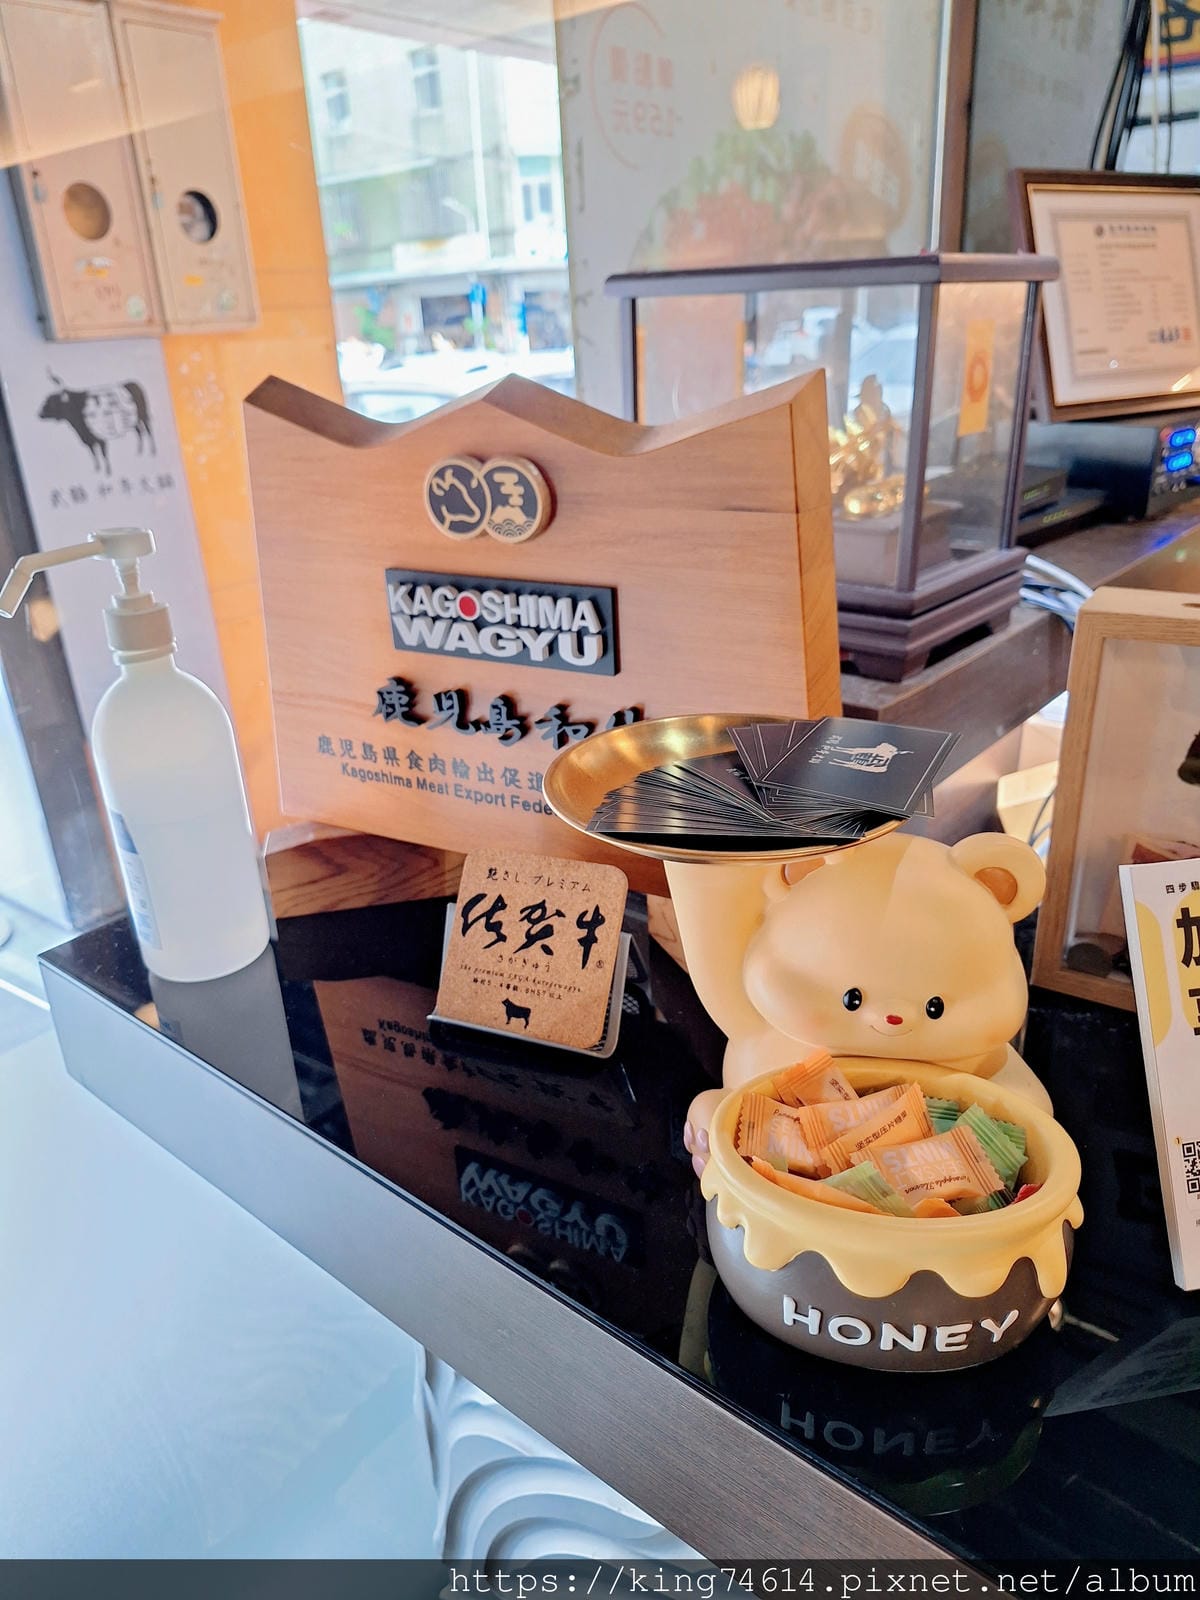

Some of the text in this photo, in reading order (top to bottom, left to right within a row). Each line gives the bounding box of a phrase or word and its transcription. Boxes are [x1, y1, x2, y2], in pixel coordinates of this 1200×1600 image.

[387, 582, 603, 634] KAGOSHIMA
[391, 614, 604, 666] WAGYU
[340, 761, 558, 816] Kagoshima Meat Export Fede
[460, 892, 606, 970] 佐賀牛
[783, 1294, 1020, 1353] HONEY
